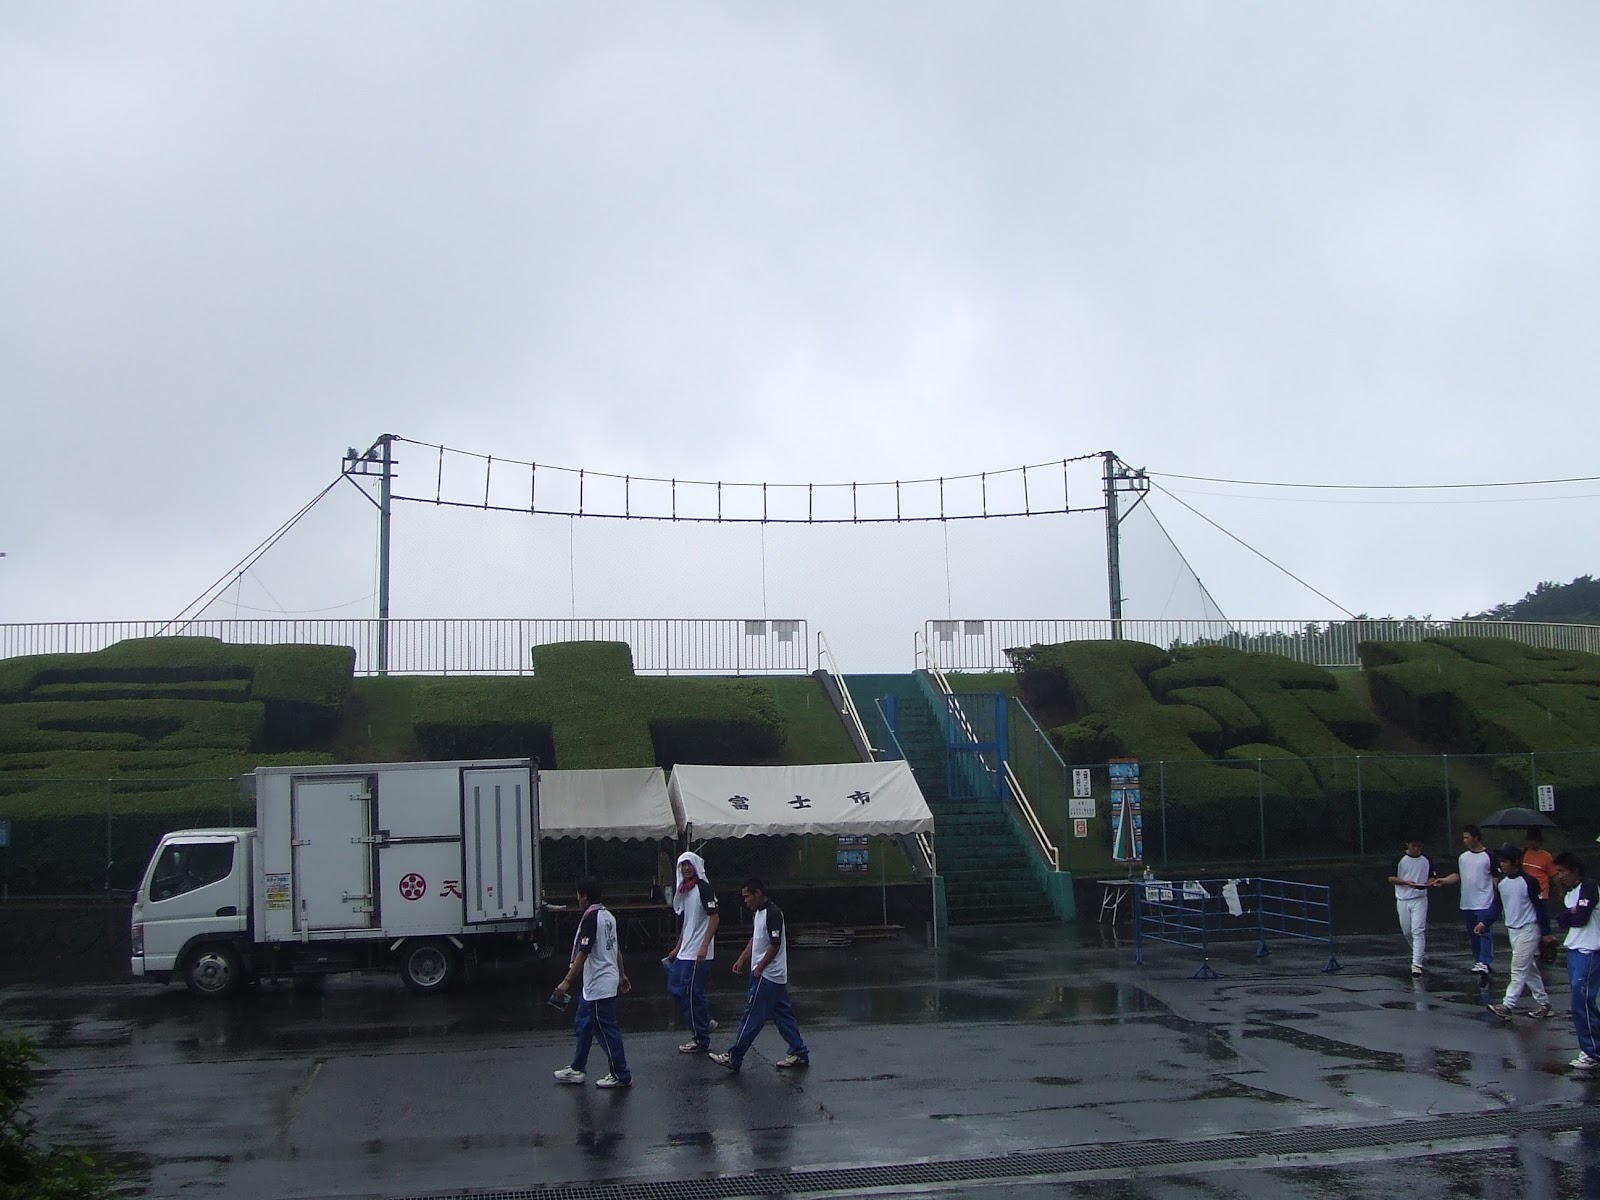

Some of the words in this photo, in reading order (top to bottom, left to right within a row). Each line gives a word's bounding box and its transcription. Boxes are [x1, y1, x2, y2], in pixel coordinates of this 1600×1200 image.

[728, 790, 871, 811] 富士市
[439, 880, 463, 899] 天
